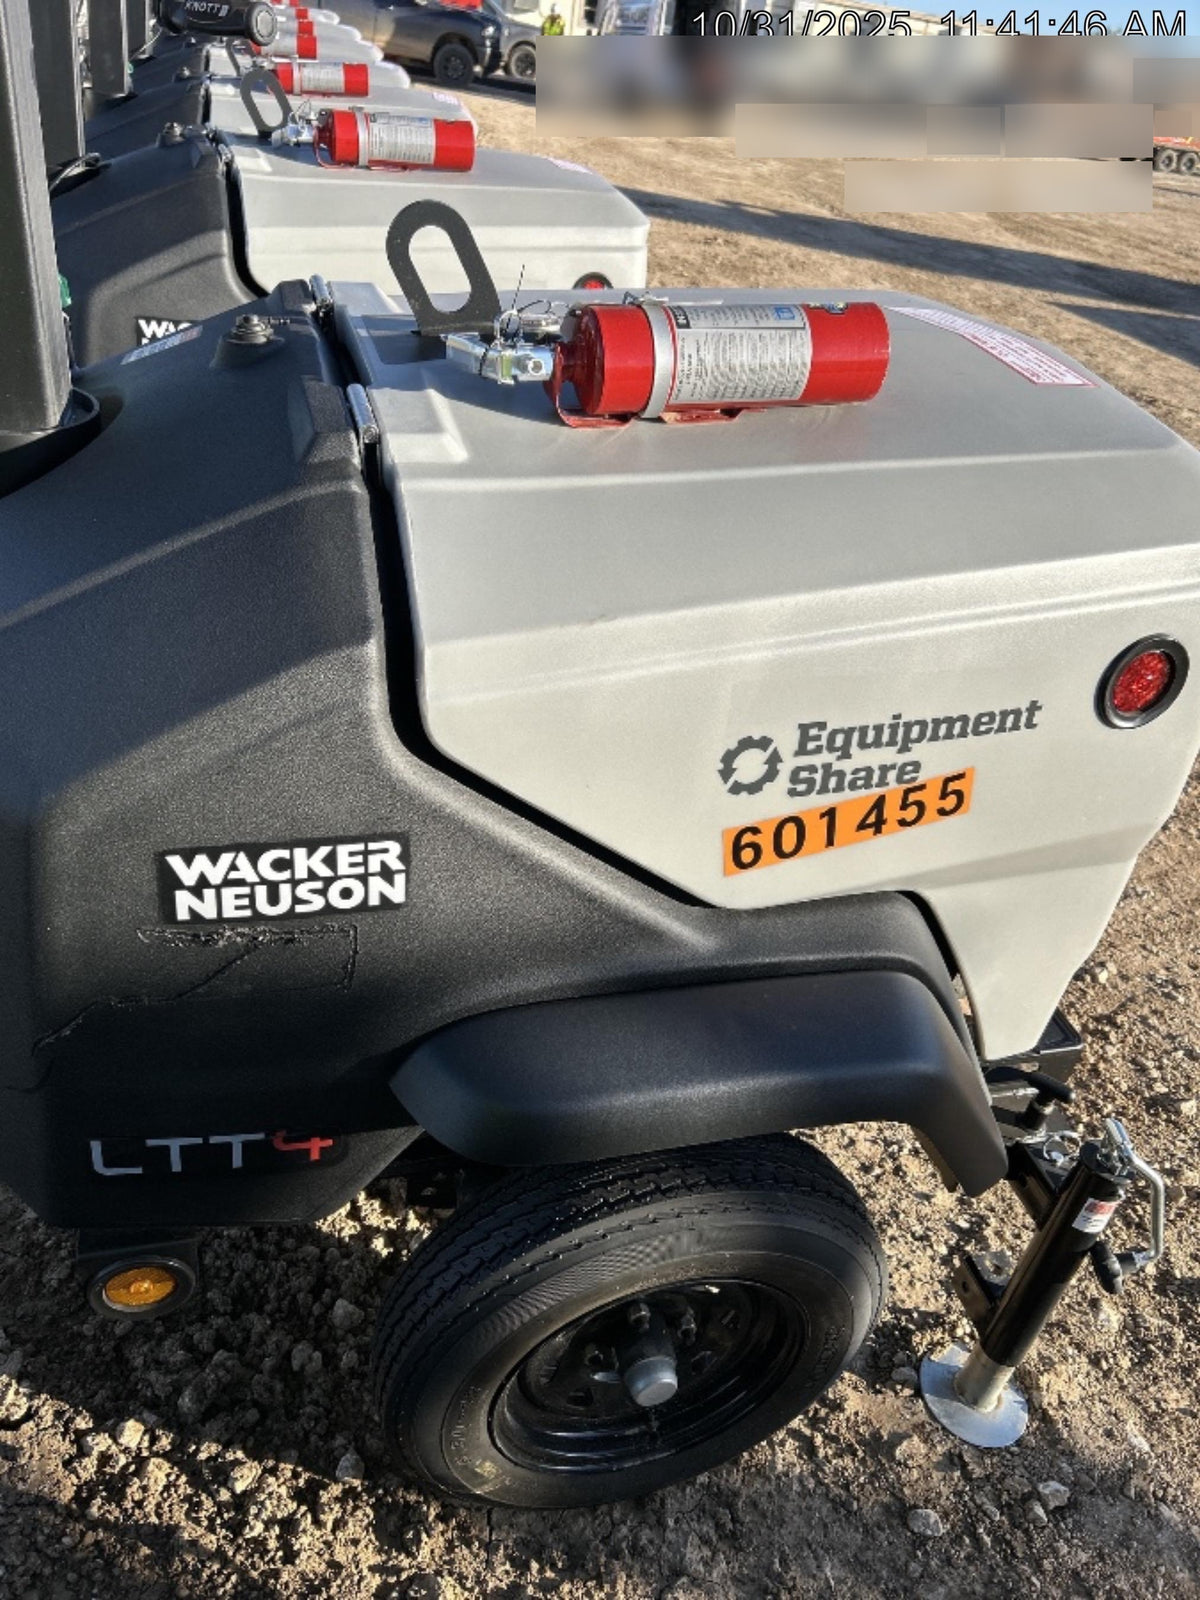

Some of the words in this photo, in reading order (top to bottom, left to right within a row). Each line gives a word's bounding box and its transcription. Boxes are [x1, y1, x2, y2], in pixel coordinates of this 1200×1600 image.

[184, 1, 221, 13] KNOTT
[793, 699, 1043, 760] Equipment
[787, 759, 922, 798] Share
[731, 771, 967, 871] 601455
[165, 839, 406, 887] WACKER
[175, 872, 406, 922] NEUSON
[90, 1130, 334, 1176] LTT4
